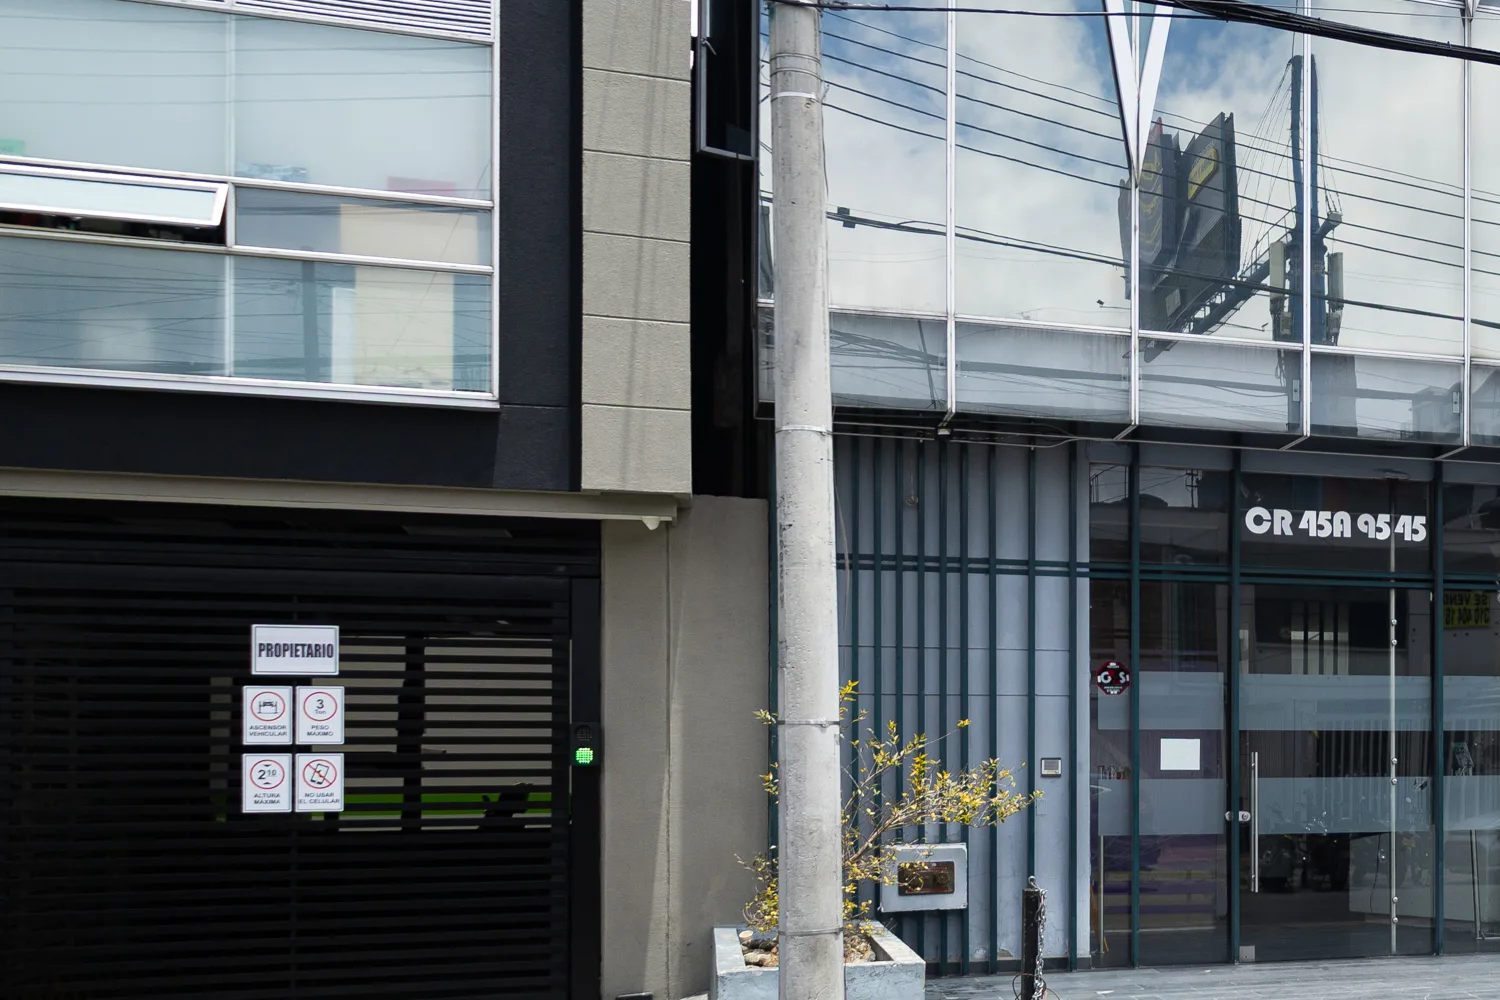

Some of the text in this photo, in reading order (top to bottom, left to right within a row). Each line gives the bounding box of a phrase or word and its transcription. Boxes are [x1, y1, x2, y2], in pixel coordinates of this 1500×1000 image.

[1245, 506, 1293, 536] CR
[1298, 510, 1352, 538] 45A
[1394, 515, 1427, 542] 45
[258, 643, 334, 658] PROPIETARIO
[316, 698, 325, 710] 3
